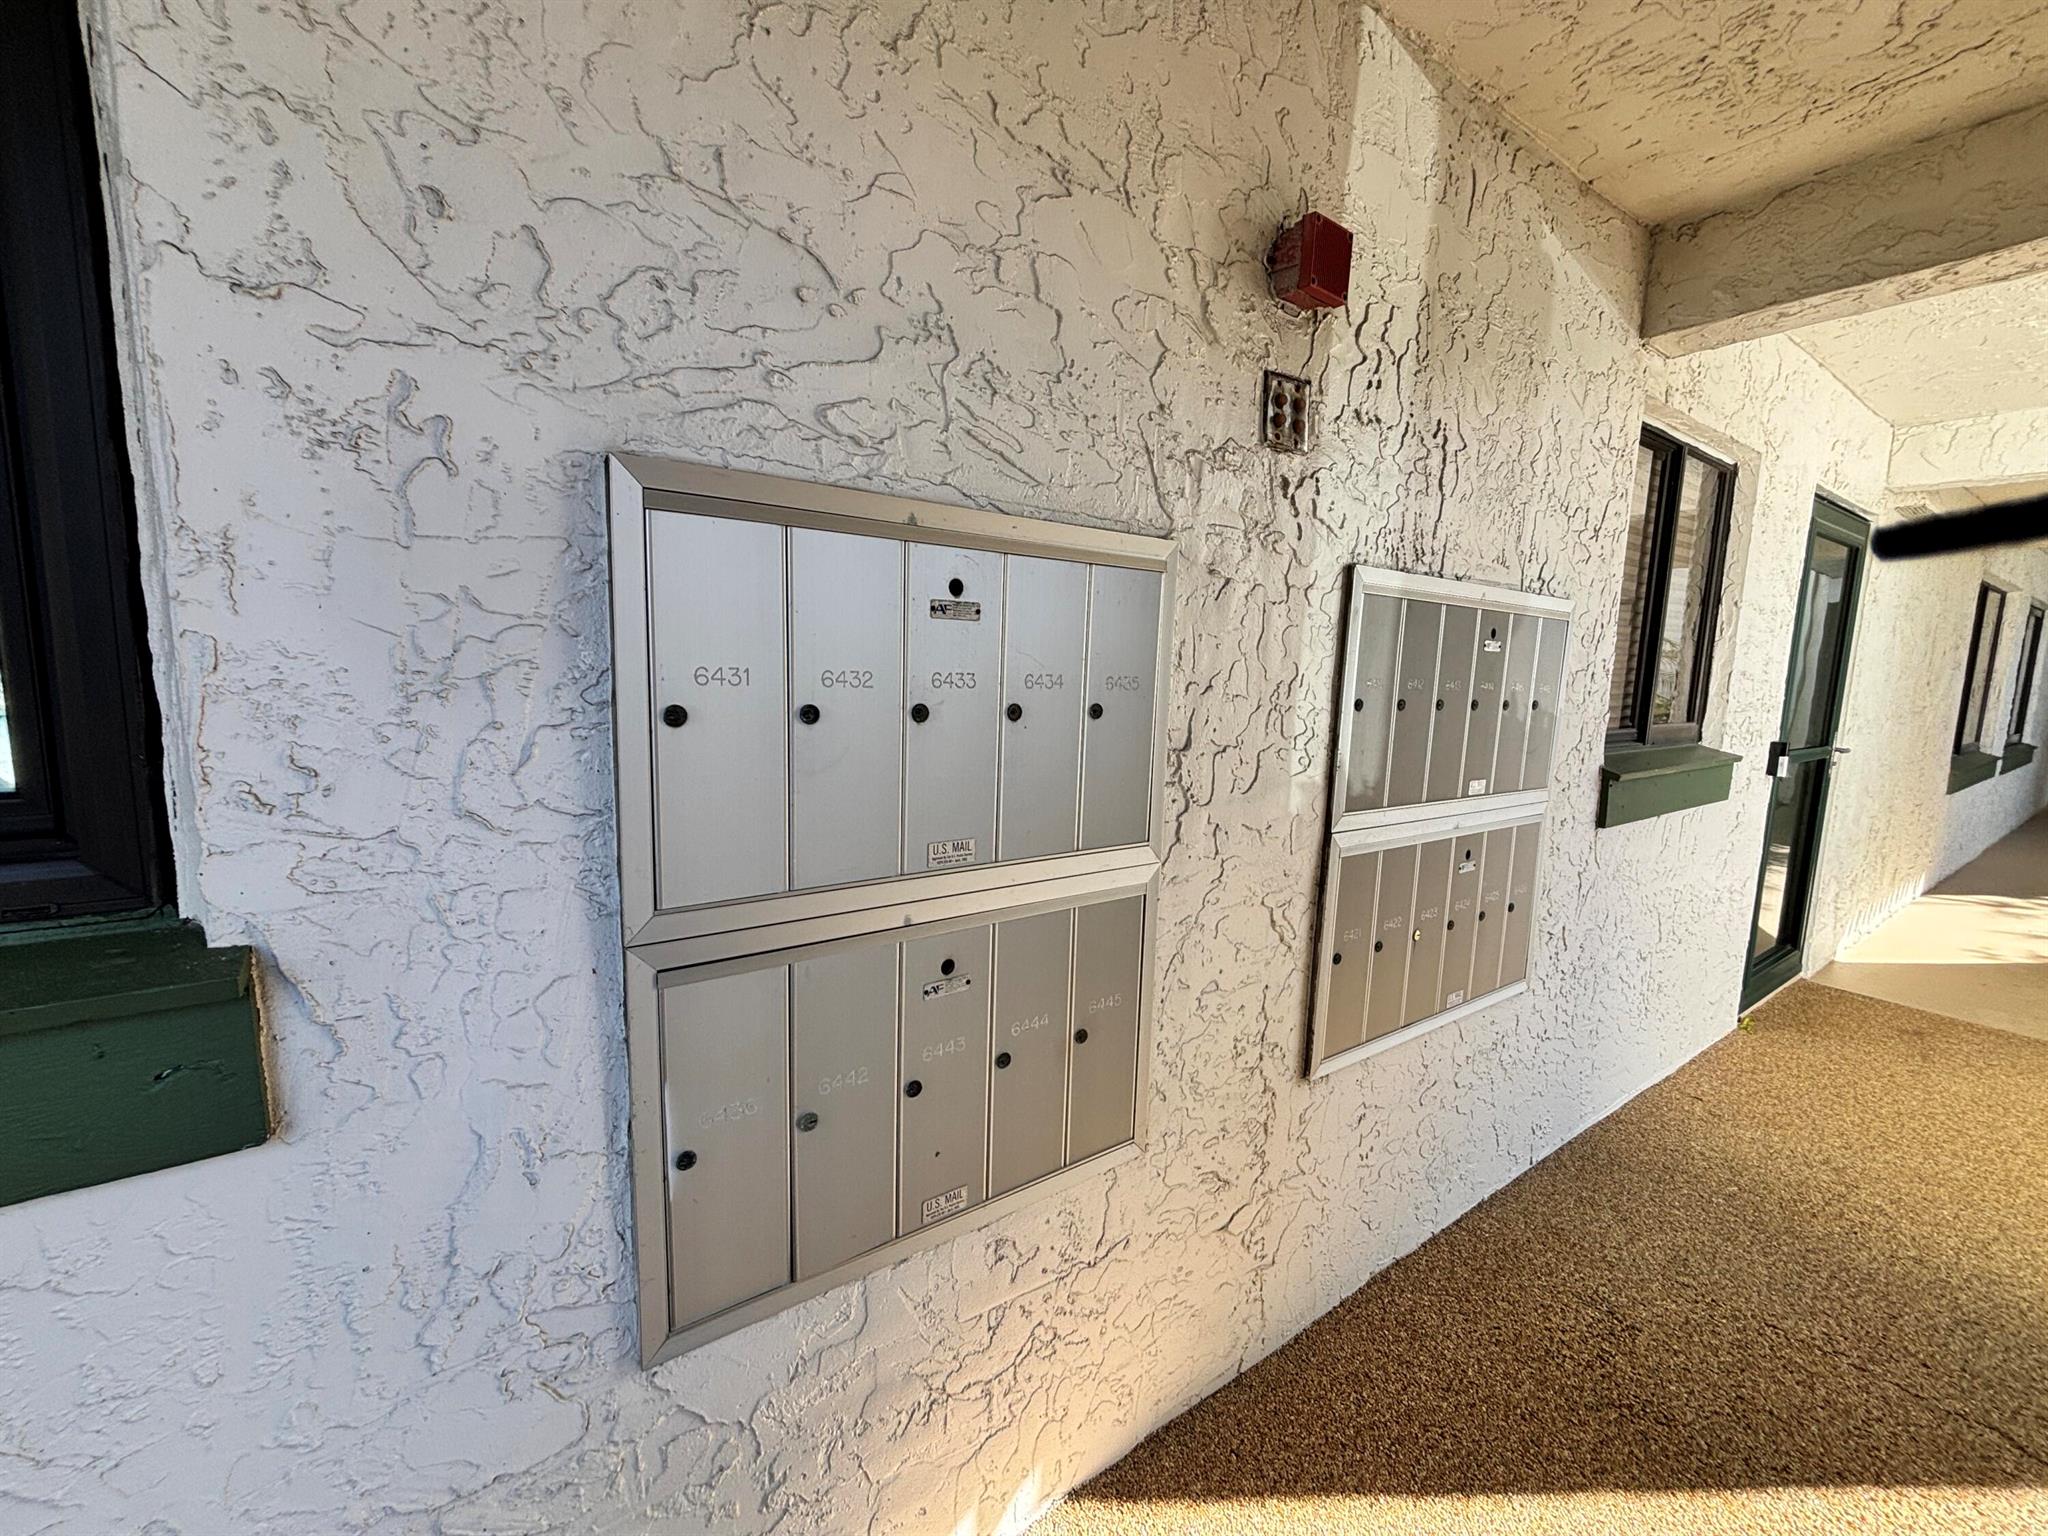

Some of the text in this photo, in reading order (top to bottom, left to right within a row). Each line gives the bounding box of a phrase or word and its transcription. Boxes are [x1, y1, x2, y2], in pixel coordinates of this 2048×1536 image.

[693, 666, 750, 686] 6431
[821, 670, 874, 689] 6432
[931, 672, 977, 689] 6433
[1024, 673, 1064, 690] 6434
[1105, 676, 1140, 691] 6435
[932, 840, 973, 856] U.S. MAIL
[1088, 993, 1122, 1014] 6445
[1011, 1013, 1049, 1036] 6444
[922, 1036, 966, 1062] 6443
[818, 1066, 869, 1095] 6442
[926, 1198, 942, 1212] U.S.
[944, 1189, 963, 1205] MAIL
